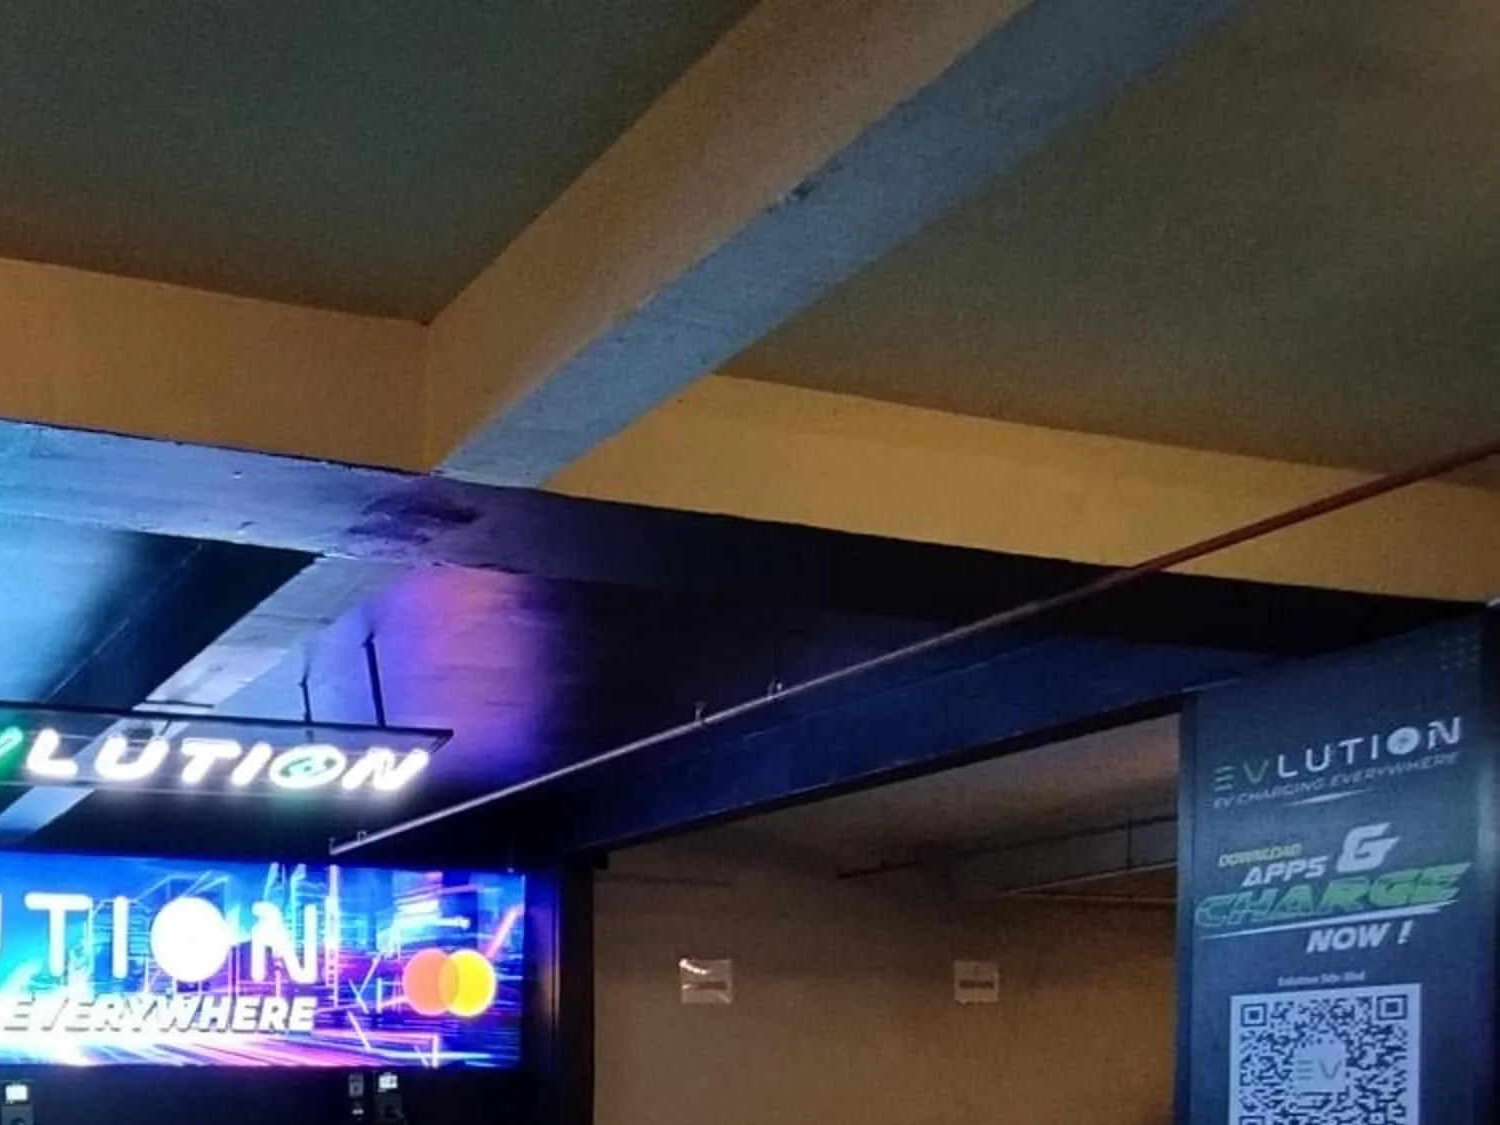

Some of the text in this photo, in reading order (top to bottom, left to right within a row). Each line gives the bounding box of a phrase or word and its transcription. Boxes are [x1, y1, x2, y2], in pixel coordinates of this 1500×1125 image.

[1213, 716, 1461, 792] EVLUTION
[1242, 855, 1328, 887] APPS
[1195, 862, 1472, 927] CHARGE
[1306, 922, 1391, 953] NOW
[2, 990, 317, 1034] EVERYWHERE
